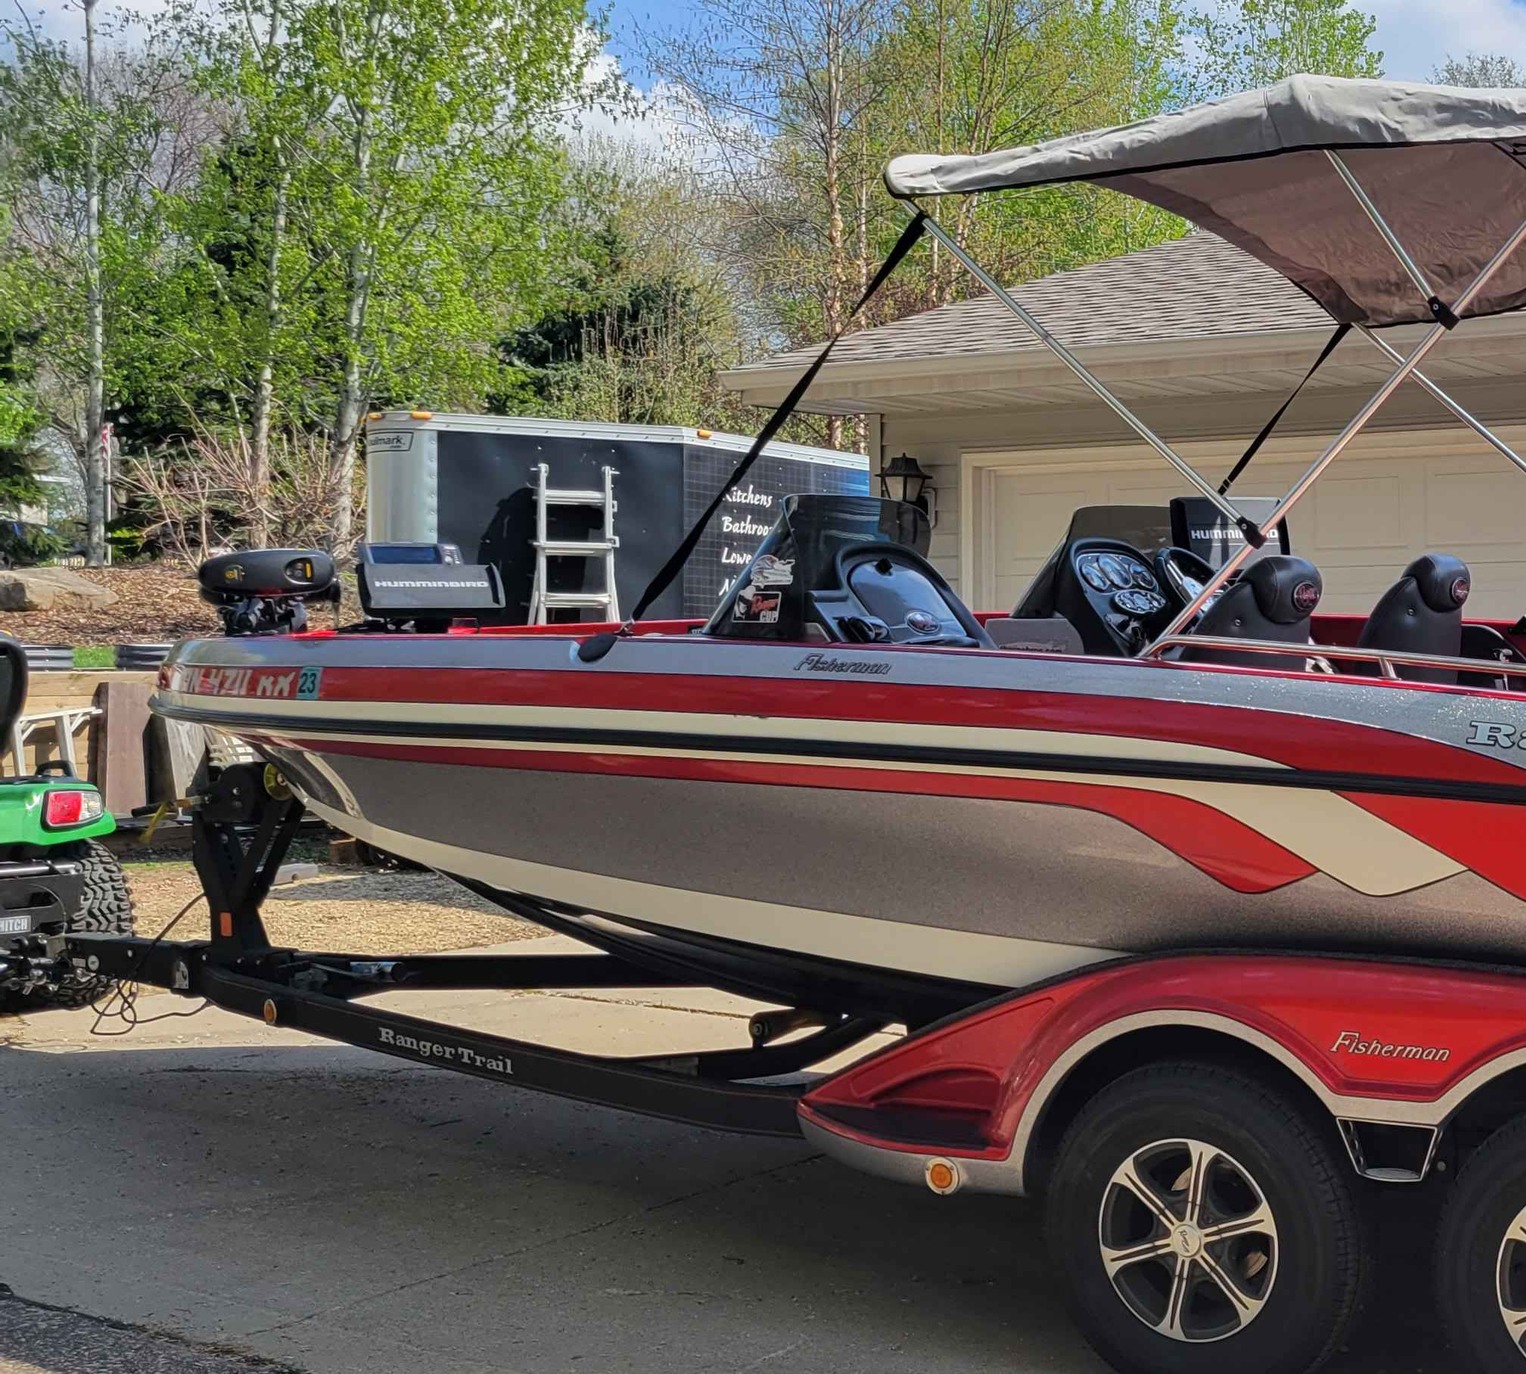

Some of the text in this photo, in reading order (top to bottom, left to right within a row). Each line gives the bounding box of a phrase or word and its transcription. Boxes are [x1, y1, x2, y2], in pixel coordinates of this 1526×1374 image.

[374, 580, 489, 588] HUMMINBIRD
[793, 652, 892, 676] Fisherman
[300, 672, 316, 694] 23
[378, 1027, 514, 1074] Ranger Trail
[1329, 1031, 1451, 1062] Fisherman
